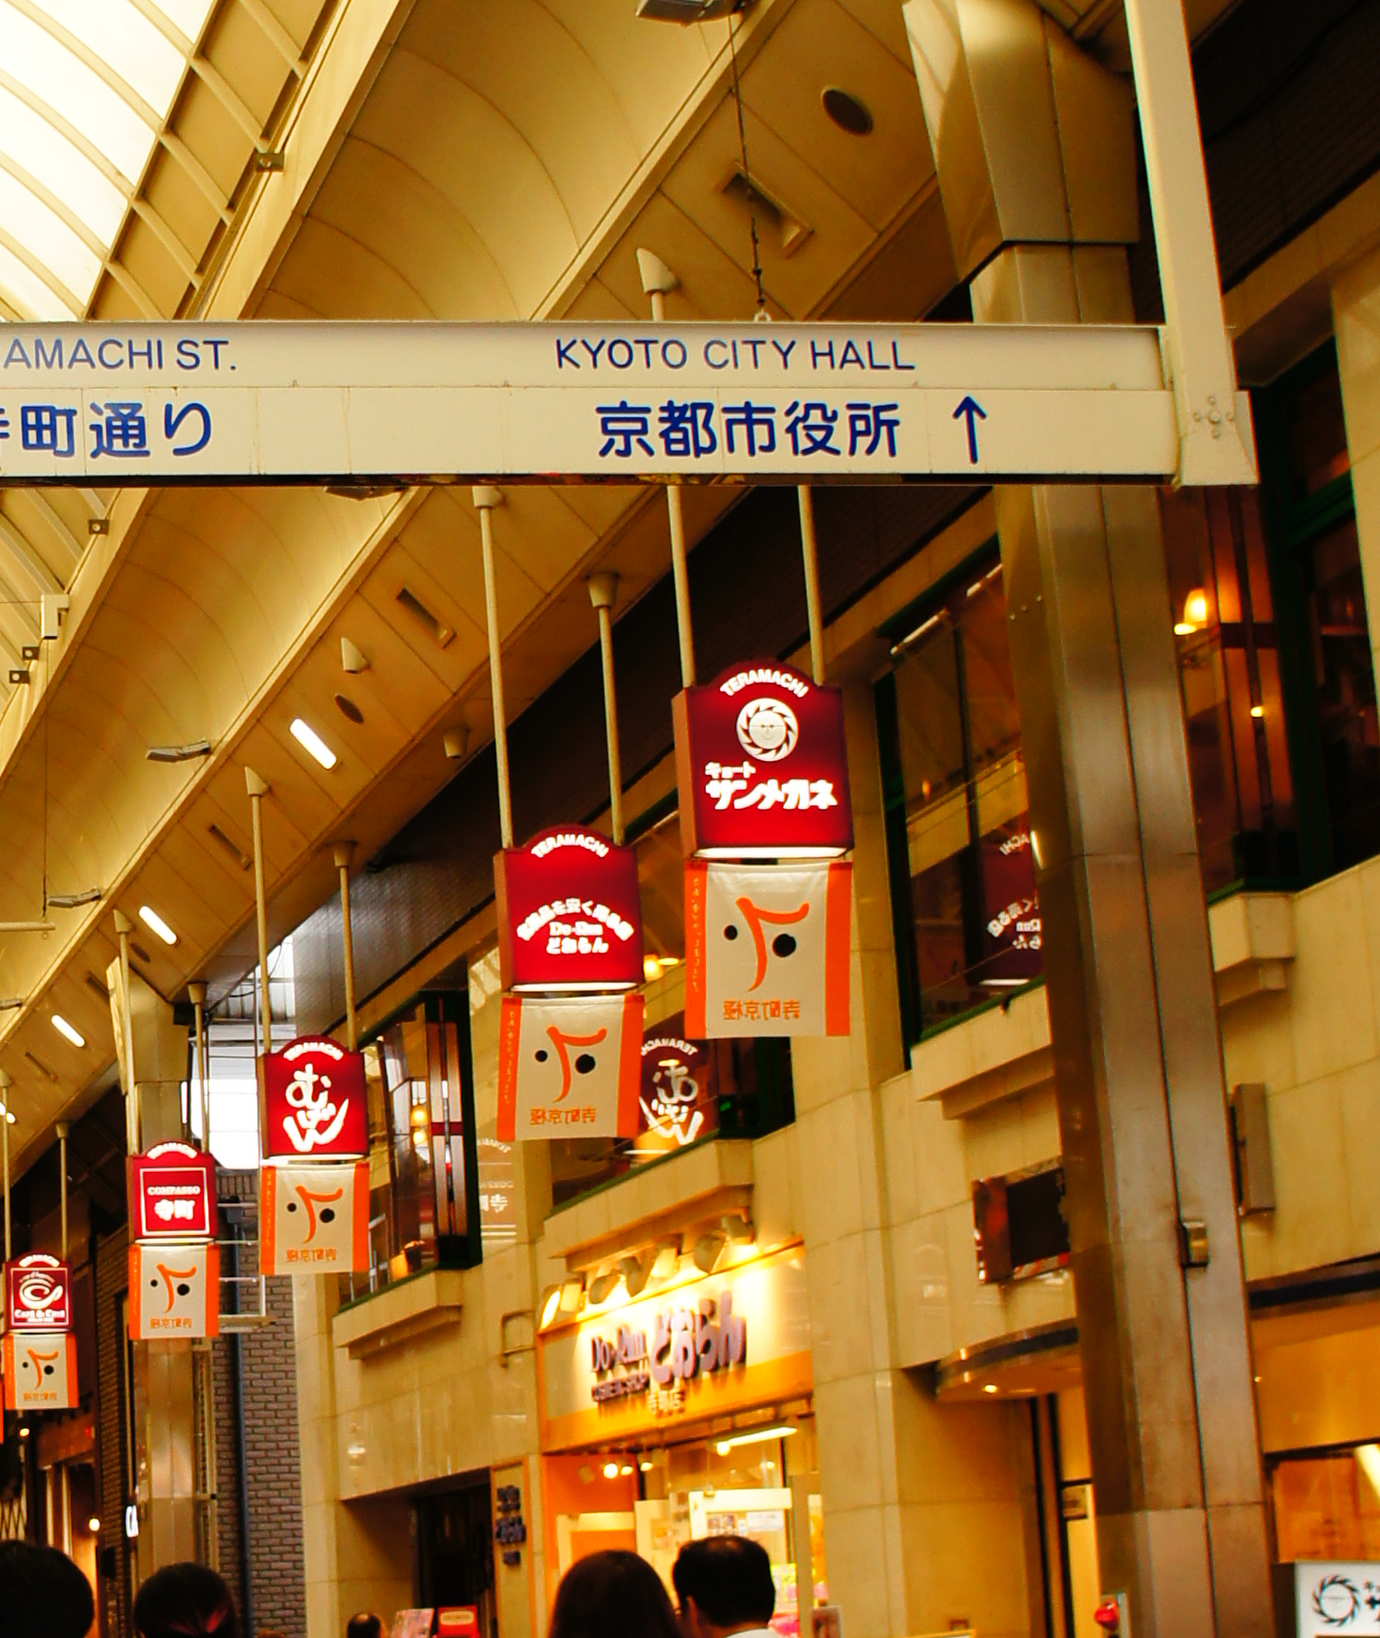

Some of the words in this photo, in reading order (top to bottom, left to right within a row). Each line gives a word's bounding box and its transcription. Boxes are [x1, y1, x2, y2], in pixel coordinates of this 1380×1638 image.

[176, 339, 237, 371] ST.
[556, 338, 687, 370] KYOTO
[703, 339, 797, 370] CITY
[810, 339, 916, 371] HALL
[595, 400, 900, 458] 京都市役所
[719, 668, 809, 698] TERAMACHI
[705, 779, 838, 811] サンメガネ
[531, 833, 610, 859] TERAMACHI
